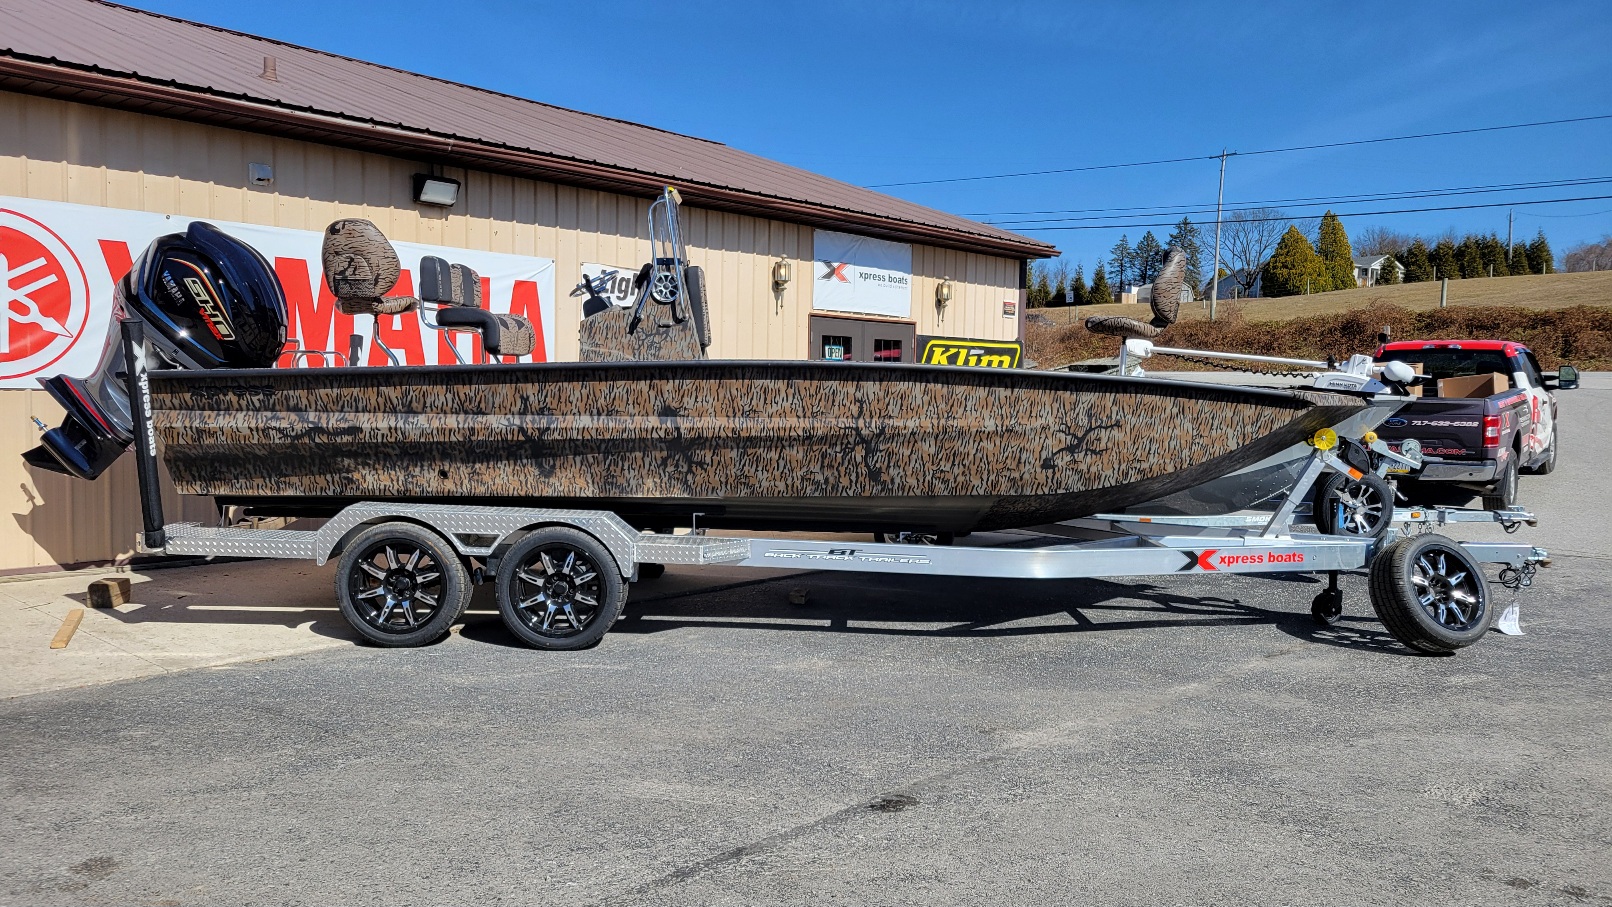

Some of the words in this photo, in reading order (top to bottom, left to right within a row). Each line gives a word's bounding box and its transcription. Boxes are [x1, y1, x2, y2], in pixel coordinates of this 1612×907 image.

[162, 270, 185, 307] YAMAHA
[858, 271, 886, 282] xpress
[888, 273, 908, 285] boats
[183, 277, 236, 340] SHO
[828, 347, 844, 359] OPEN
[138, 372, 152, 418] xpress
[146, 419, 157, 457] boats
[1218, 554, 1264, 567] xpress
[1267, 551, 1304, 563] boats
